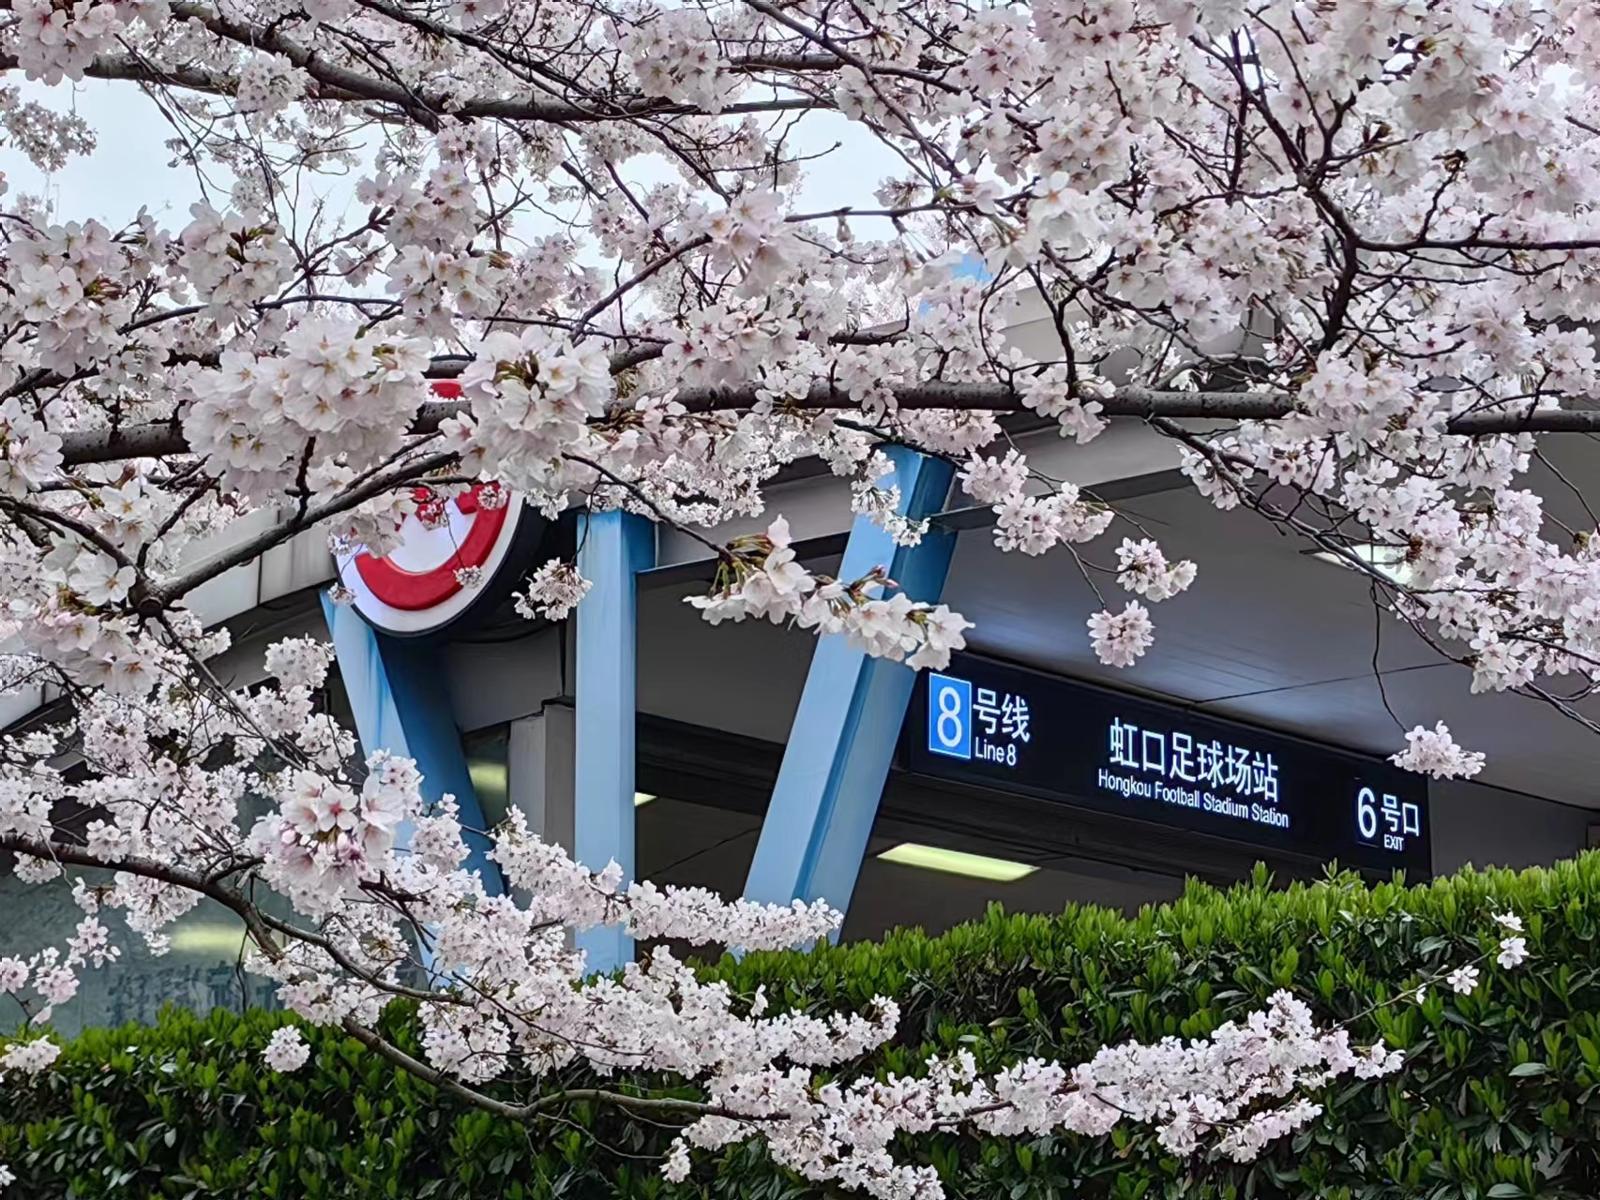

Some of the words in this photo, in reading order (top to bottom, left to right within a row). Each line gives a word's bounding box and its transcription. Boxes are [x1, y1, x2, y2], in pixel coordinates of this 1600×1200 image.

[936, 685, 963, 748] 8
[972, 687, 1031, 743] 号线
[974, 736, 1005, 763] Line
[1006, 743, 1017, 766] 8
[1109, 716, 1279, 803] 虹口足球场站
[1098, 768, 1152, 798] Hongkou
[1154, 781, 1200, 808] Football
[1203, 792, 1249, 820] Stadium
[1251, 803, 1289, 829] Station
[1357, 787, 1377, 839] 6
[1380, 793, 1420, 837] 号口
[1383, 833, 1404, 851] EXIT
